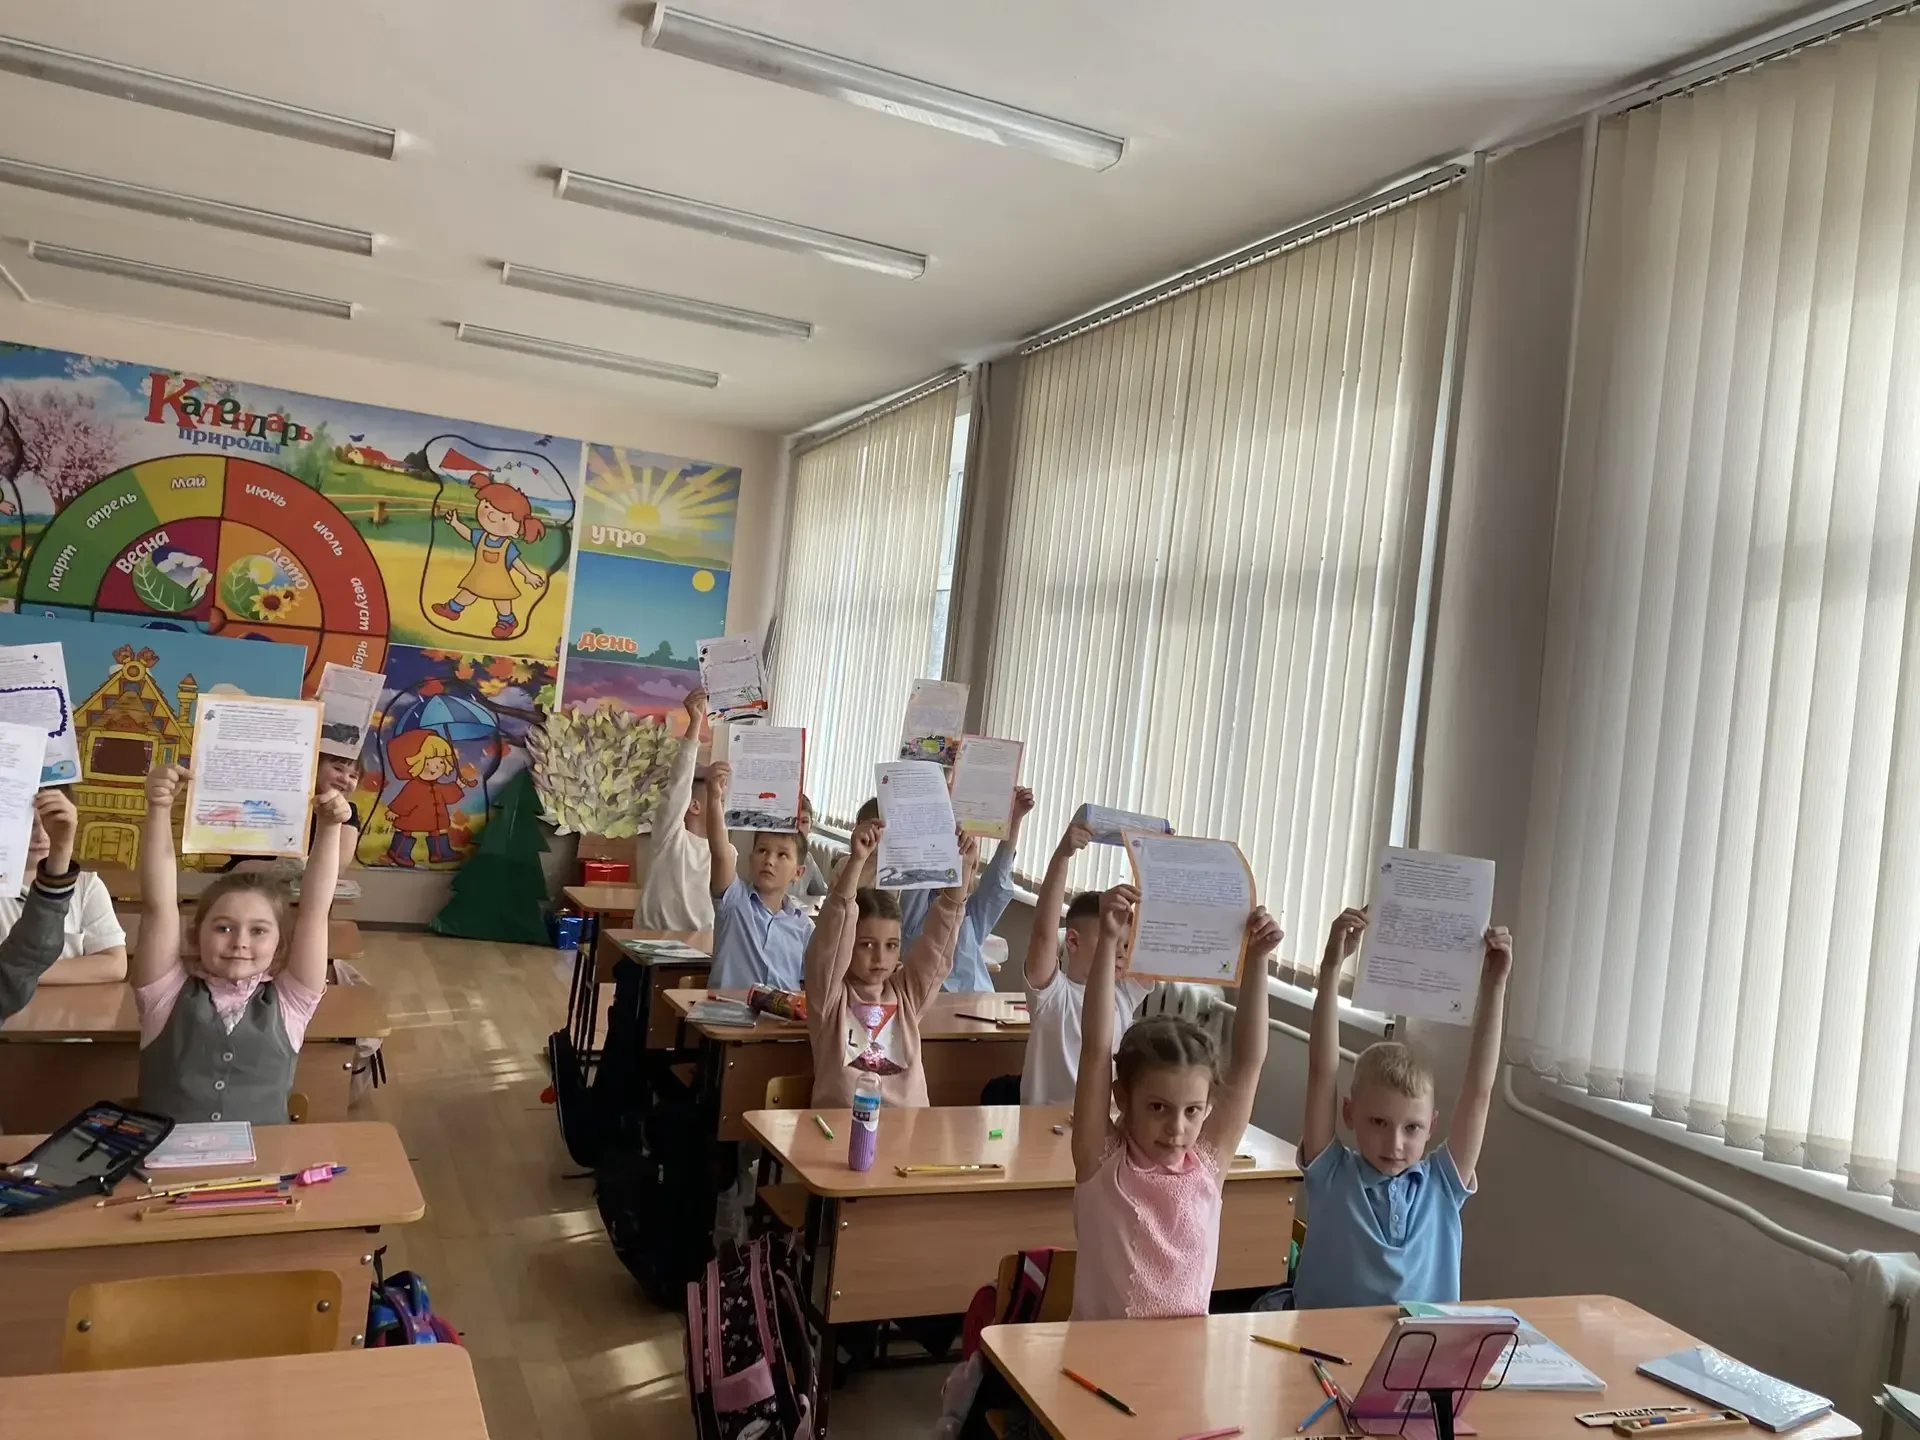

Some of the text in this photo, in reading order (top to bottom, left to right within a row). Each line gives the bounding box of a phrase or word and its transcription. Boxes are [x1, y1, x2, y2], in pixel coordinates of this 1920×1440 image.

[144, 372, 313, 447] Календарь
[178, 427, 281, 455] природы
[171, 475, 206, 489] май
[245, 483, 287, 507] июнь
[86, 493, 138, 529] апрель
[115, 530, 170, 575] Весна
[312, 520, 343, 557] июль
[591, 524, 647, 549] утро
[48, 544, 77, 592] март
[266, 547, 309, 590] Лето
[350, 577, 370, 631] август
